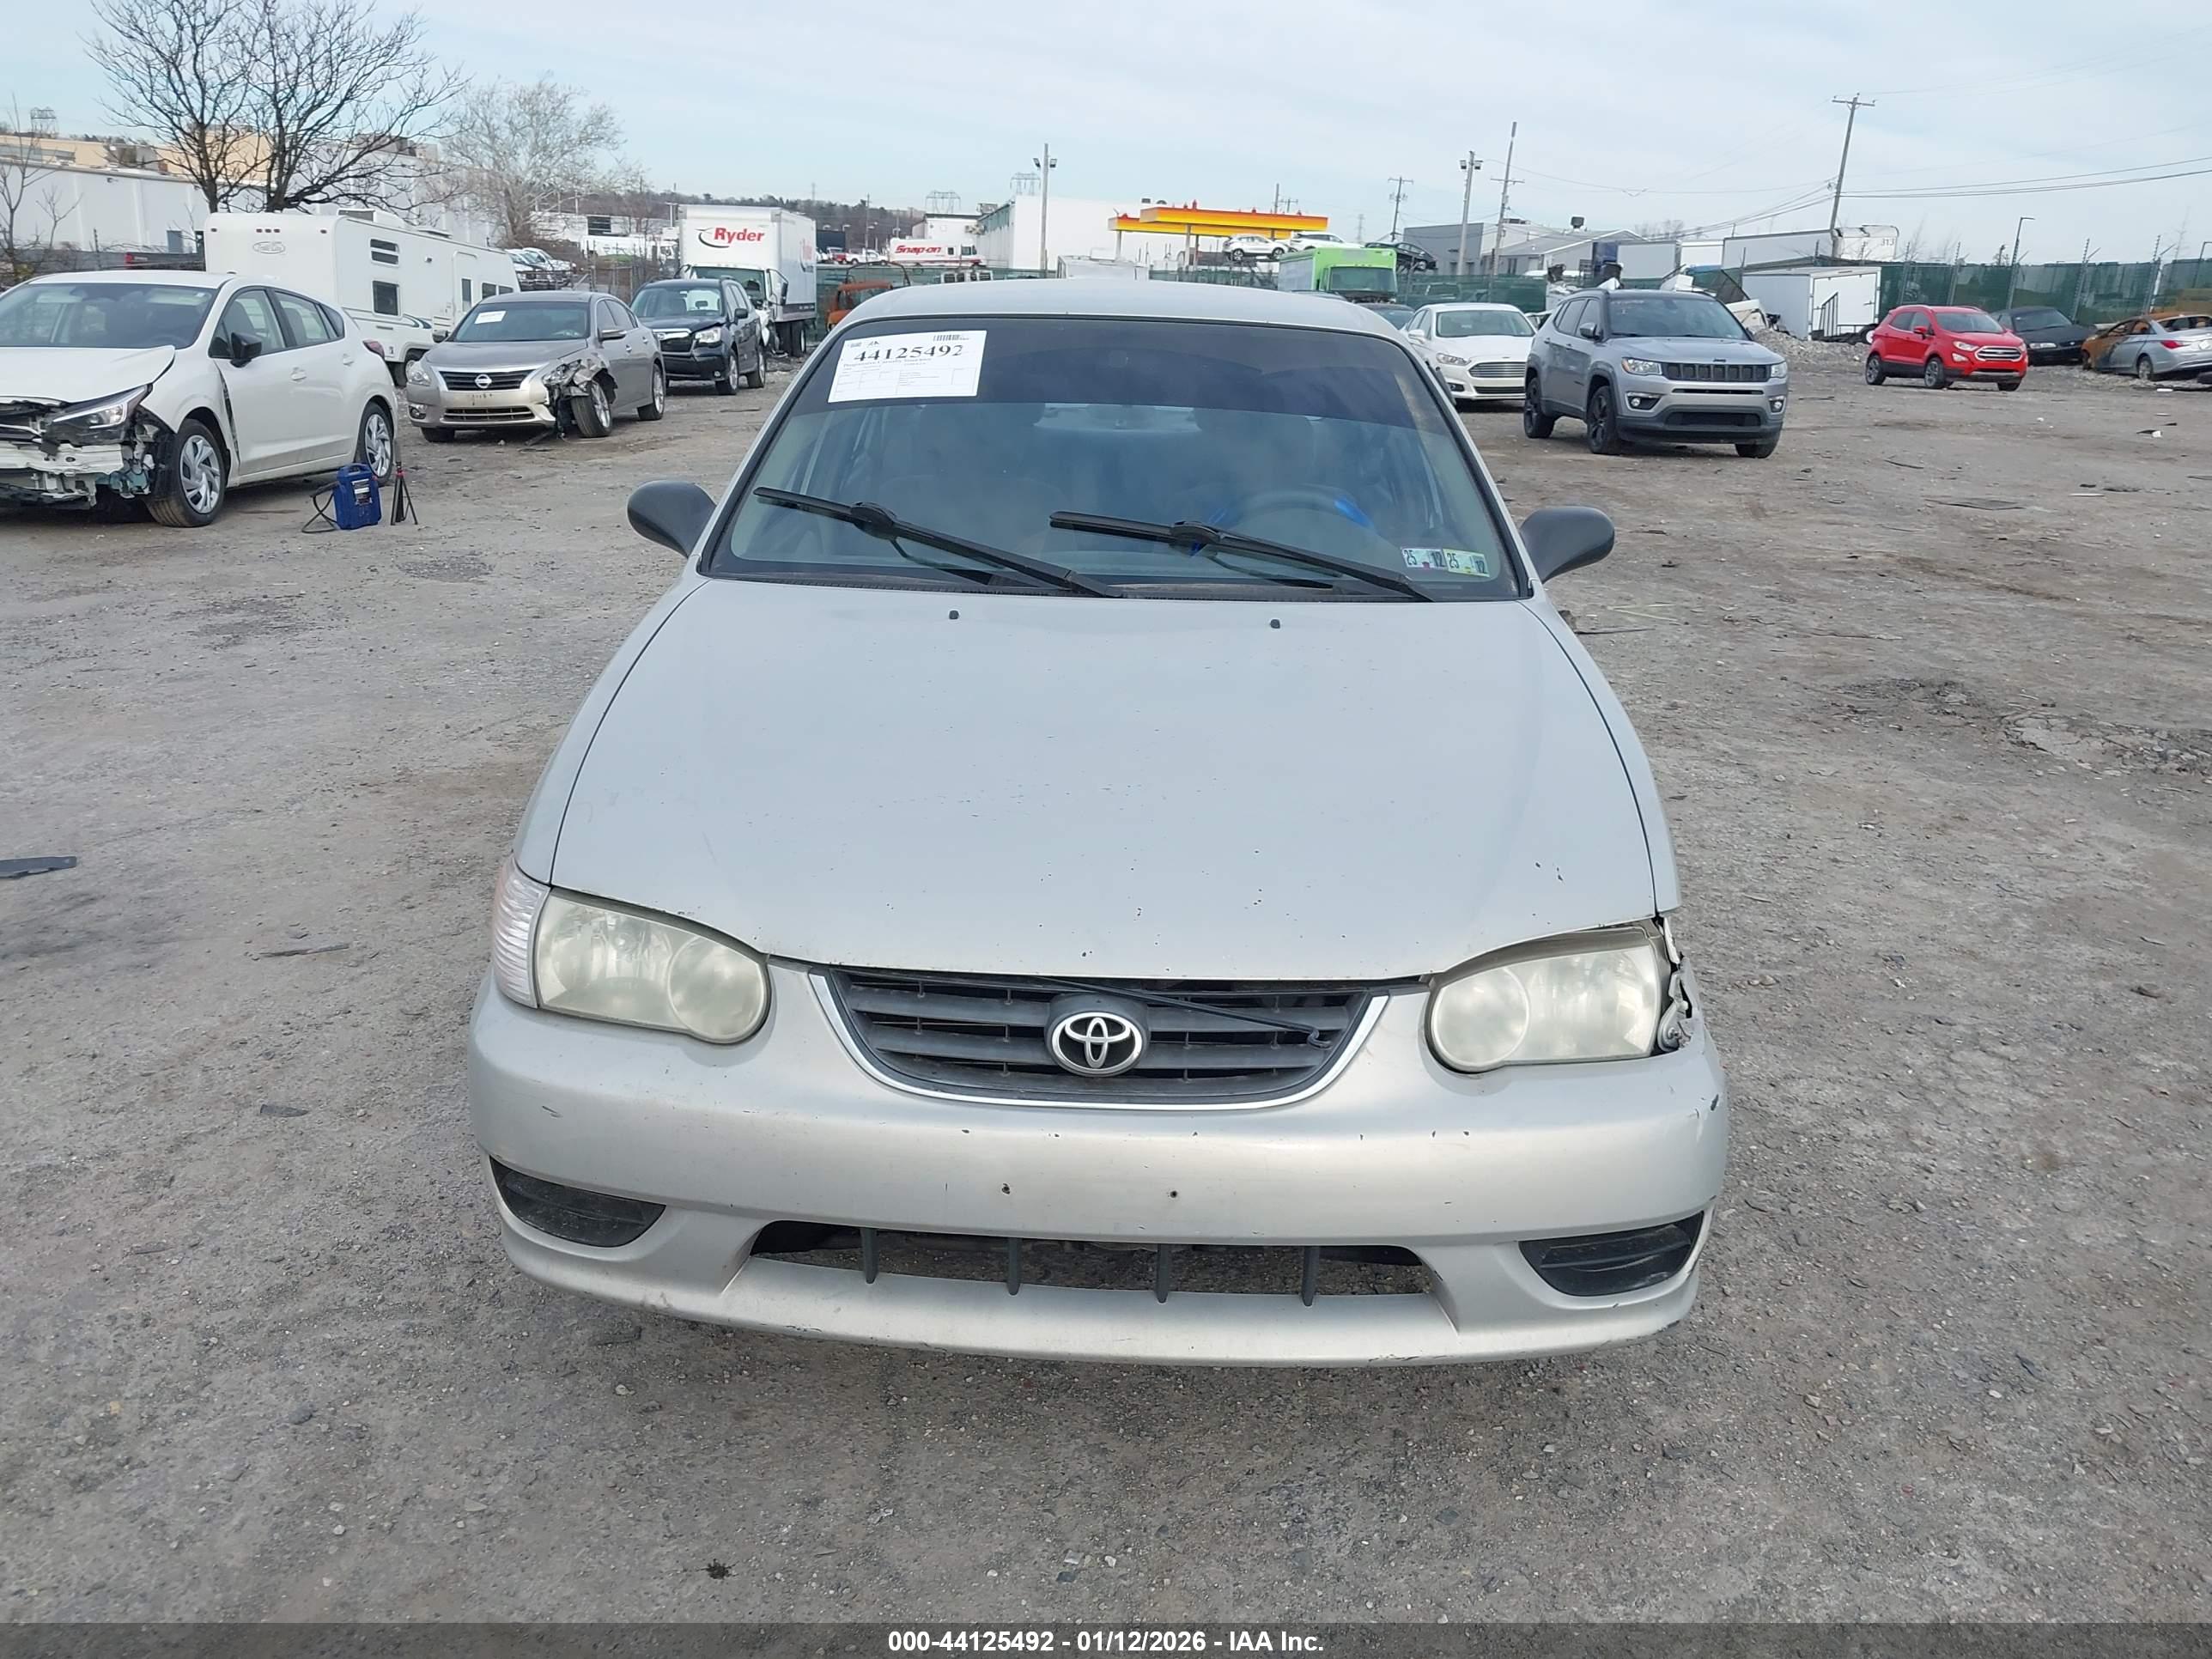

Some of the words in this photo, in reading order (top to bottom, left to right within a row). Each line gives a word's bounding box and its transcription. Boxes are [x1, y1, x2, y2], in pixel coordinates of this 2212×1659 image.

[714, 228, 764, 244] Ryder
[895, 245, 941, 255] Snap-on
[854, 344, 963, 362] 44125492
[1404, 550, 1417, 565] 25
[1431, 551, 1446, 567] 12
[1447, 553, 1460, 568] 25
[1475, 560, 1487, 574] 12
